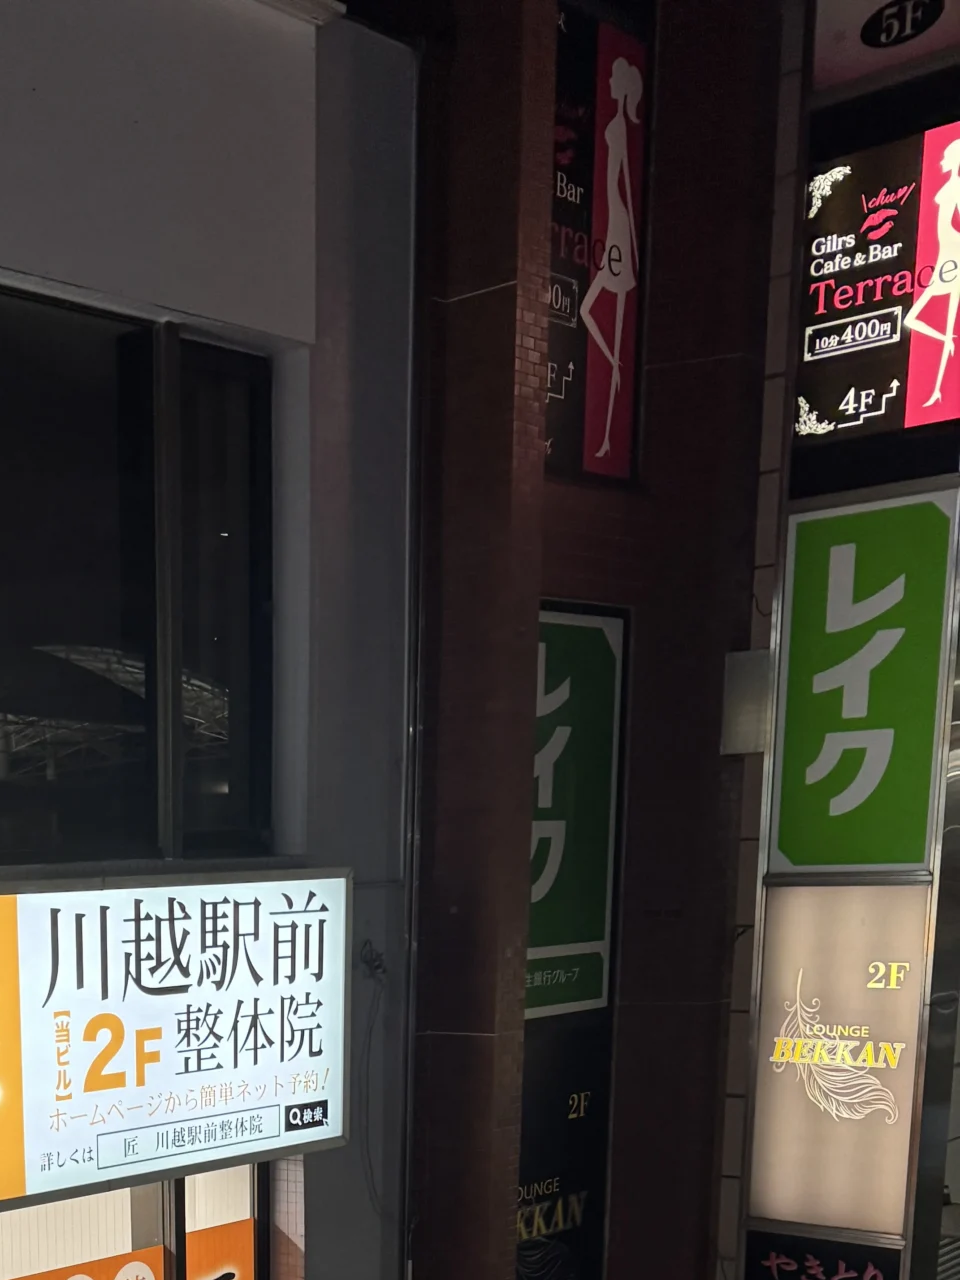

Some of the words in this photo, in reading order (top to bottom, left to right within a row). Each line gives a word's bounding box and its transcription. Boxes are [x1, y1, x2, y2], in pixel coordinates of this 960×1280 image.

[880, 0, 929, 43] 5F
[556, 171, 585, 204] Bar
[810, 254, 852, 277] Cafe
[853, 252, 866, 267] &
[868, 242, 902, 264] Bar
[811, 233, 856, 256] Gilrs
[809, 258, 958, 315] Terrace
[838, 386, 875, 416] 4F
[805, 543, 906, 816] レイク
[530, 642, 572, 903] レイク
[42, 890, 329, 1008] 川越駅前
[867, 961, 909, 989] 2F
[174, 992, 323, 1076] 整体院
[805, 1023, 870, 1038] LOUNGE
[83, 1013, 162, 1093] 2F
[770, 1037, 905, 1069] BEKKAN
[302, 1106, 324, 1124] 検索
[568, 1091, 591, 1119] 2F
[123, 1136, 138, 1158] 匠
[155, 1114, 264, 1151] 川越駅前整体院
[40, 1146, 95, 1172] 詳しくは
